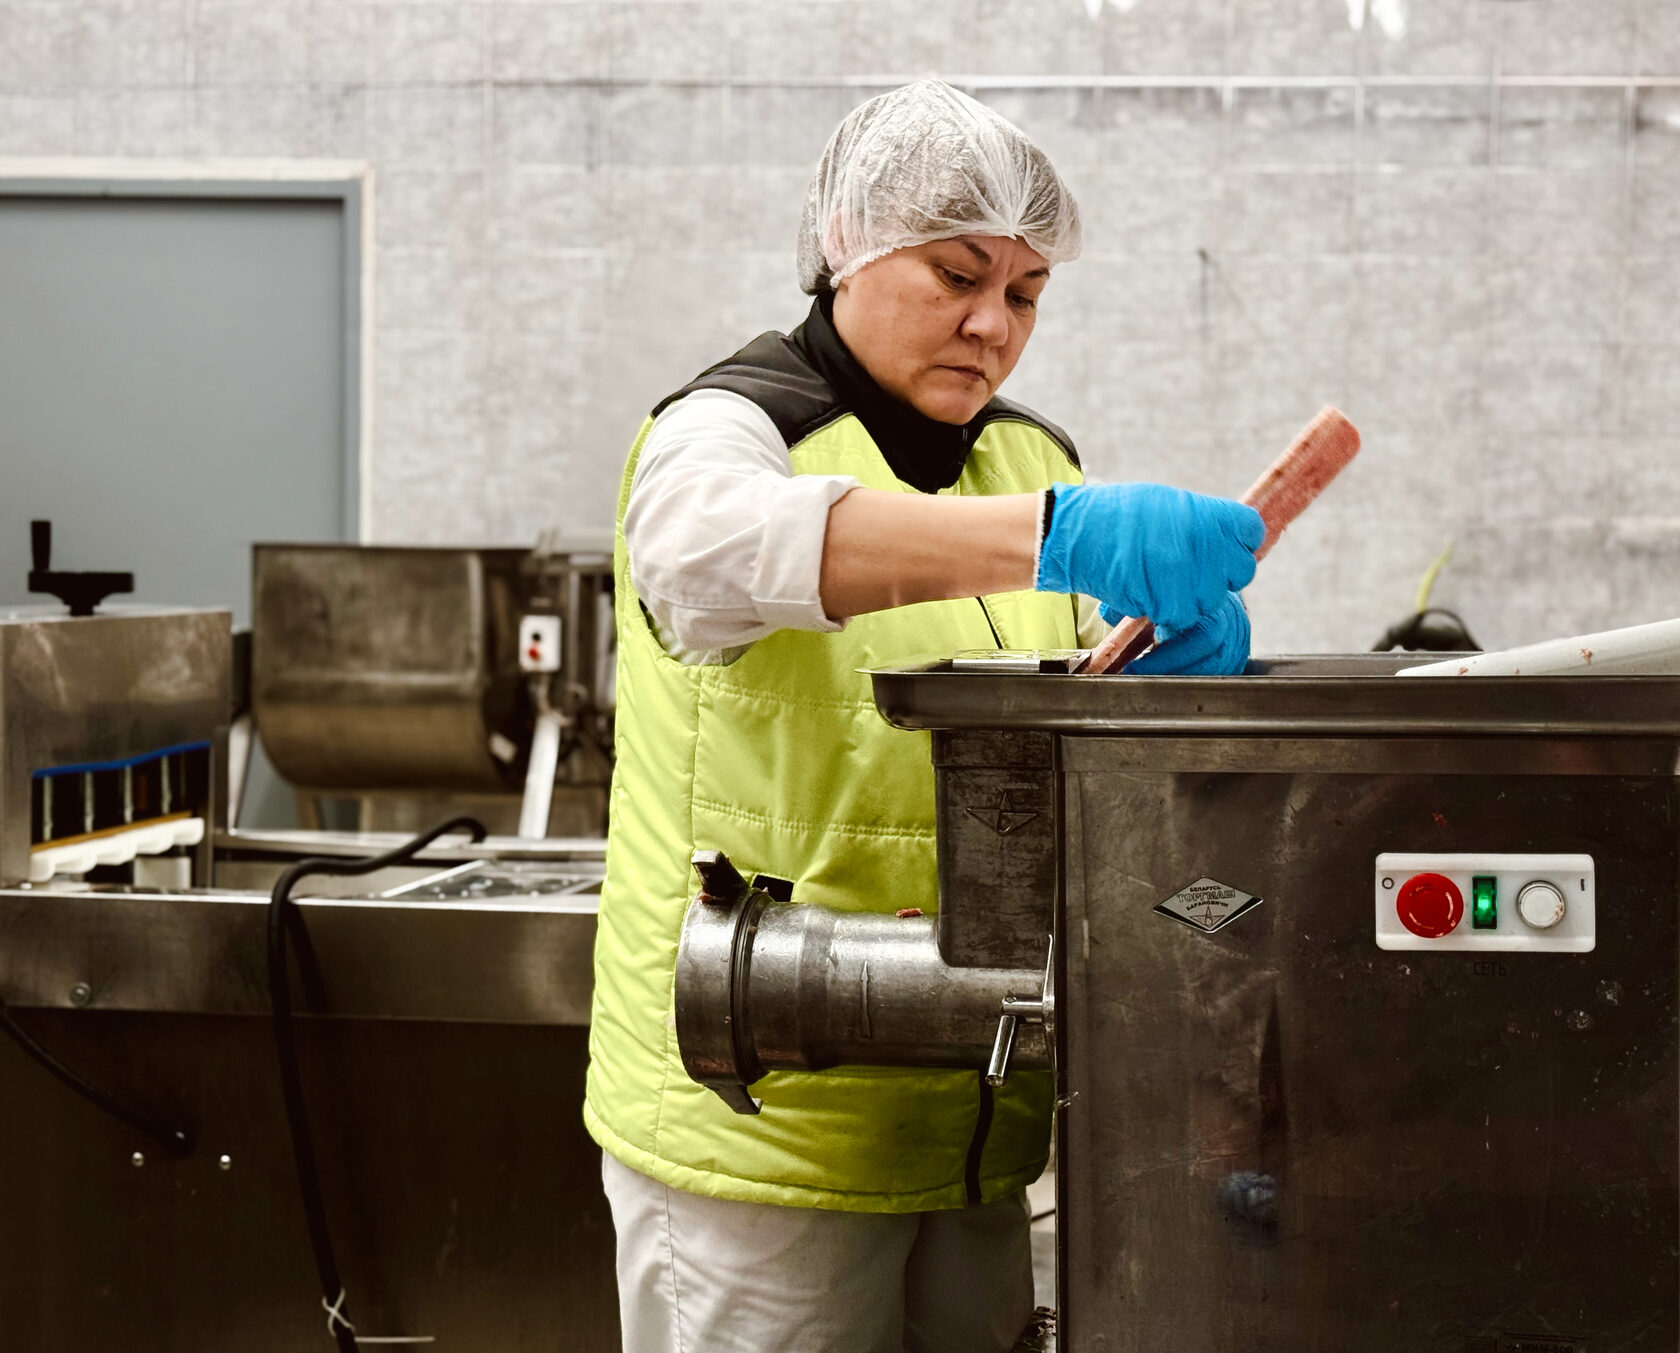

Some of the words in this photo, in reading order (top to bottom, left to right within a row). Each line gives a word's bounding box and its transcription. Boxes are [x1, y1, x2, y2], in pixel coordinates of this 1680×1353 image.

[1176, 890, 1235, 903] ТОРГМАШ
[1186, 900, 1229, 911] БАРАНОВИЧИ
[1473, 961, 1507, 976] СЕТЬ
